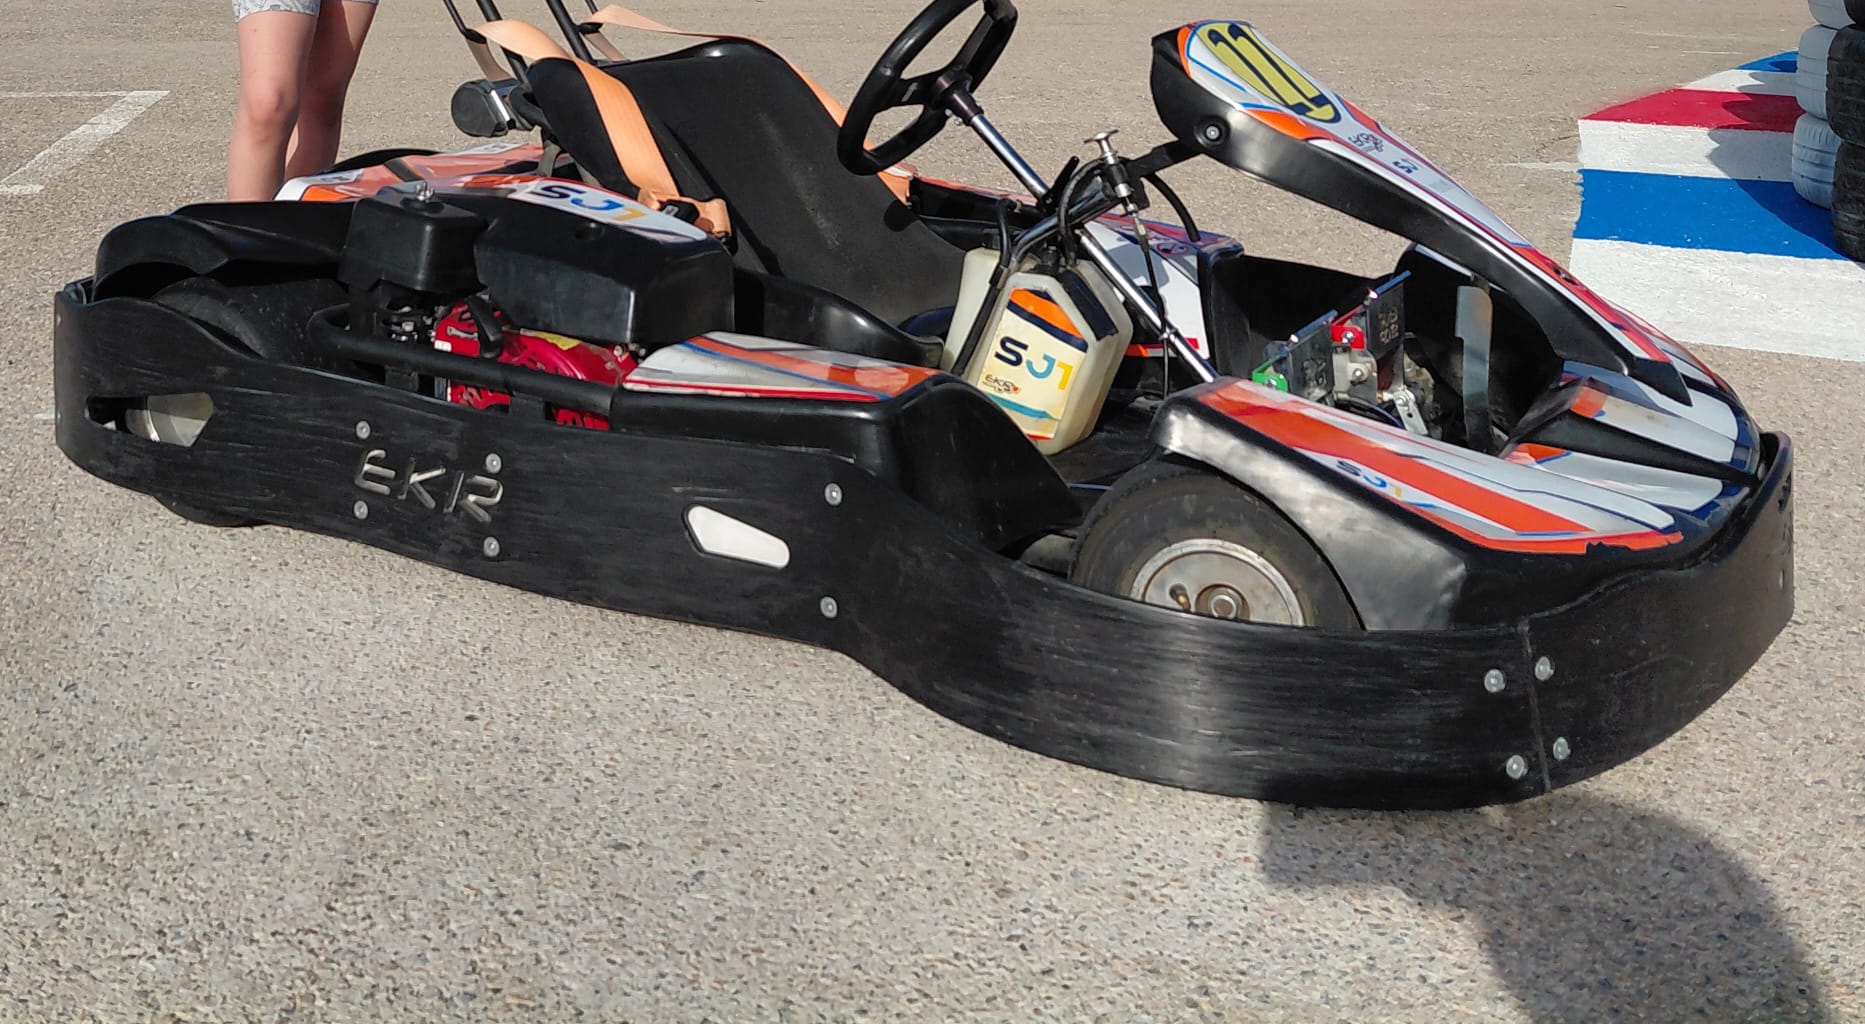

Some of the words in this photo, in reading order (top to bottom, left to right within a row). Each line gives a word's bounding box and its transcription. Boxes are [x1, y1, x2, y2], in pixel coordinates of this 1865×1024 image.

[527, 184, 647, 222] SJ1
[994, 335, 1074, 391] SJ1
[354, 448, 504, 524] EKR
[1335, 459, 1403, 499] SJ1
